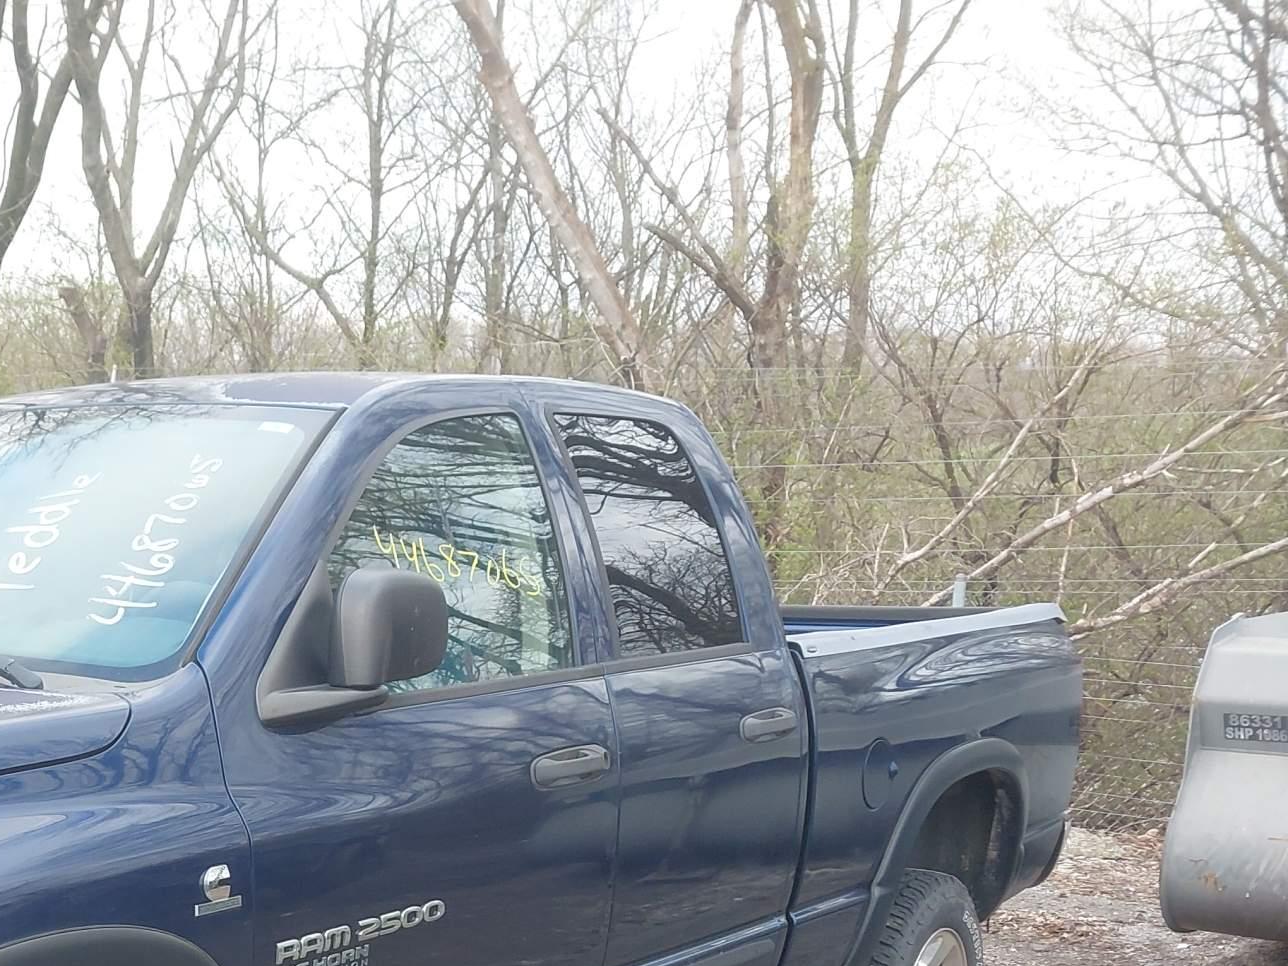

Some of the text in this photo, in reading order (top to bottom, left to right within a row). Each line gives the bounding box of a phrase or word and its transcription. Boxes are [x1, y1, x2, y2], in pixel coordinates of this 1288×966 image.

[1229, 713, 1282, 729] 86331
[1225, 726, 1254, 740] SHP
[275, 899, 446, 965] RAM 2500
